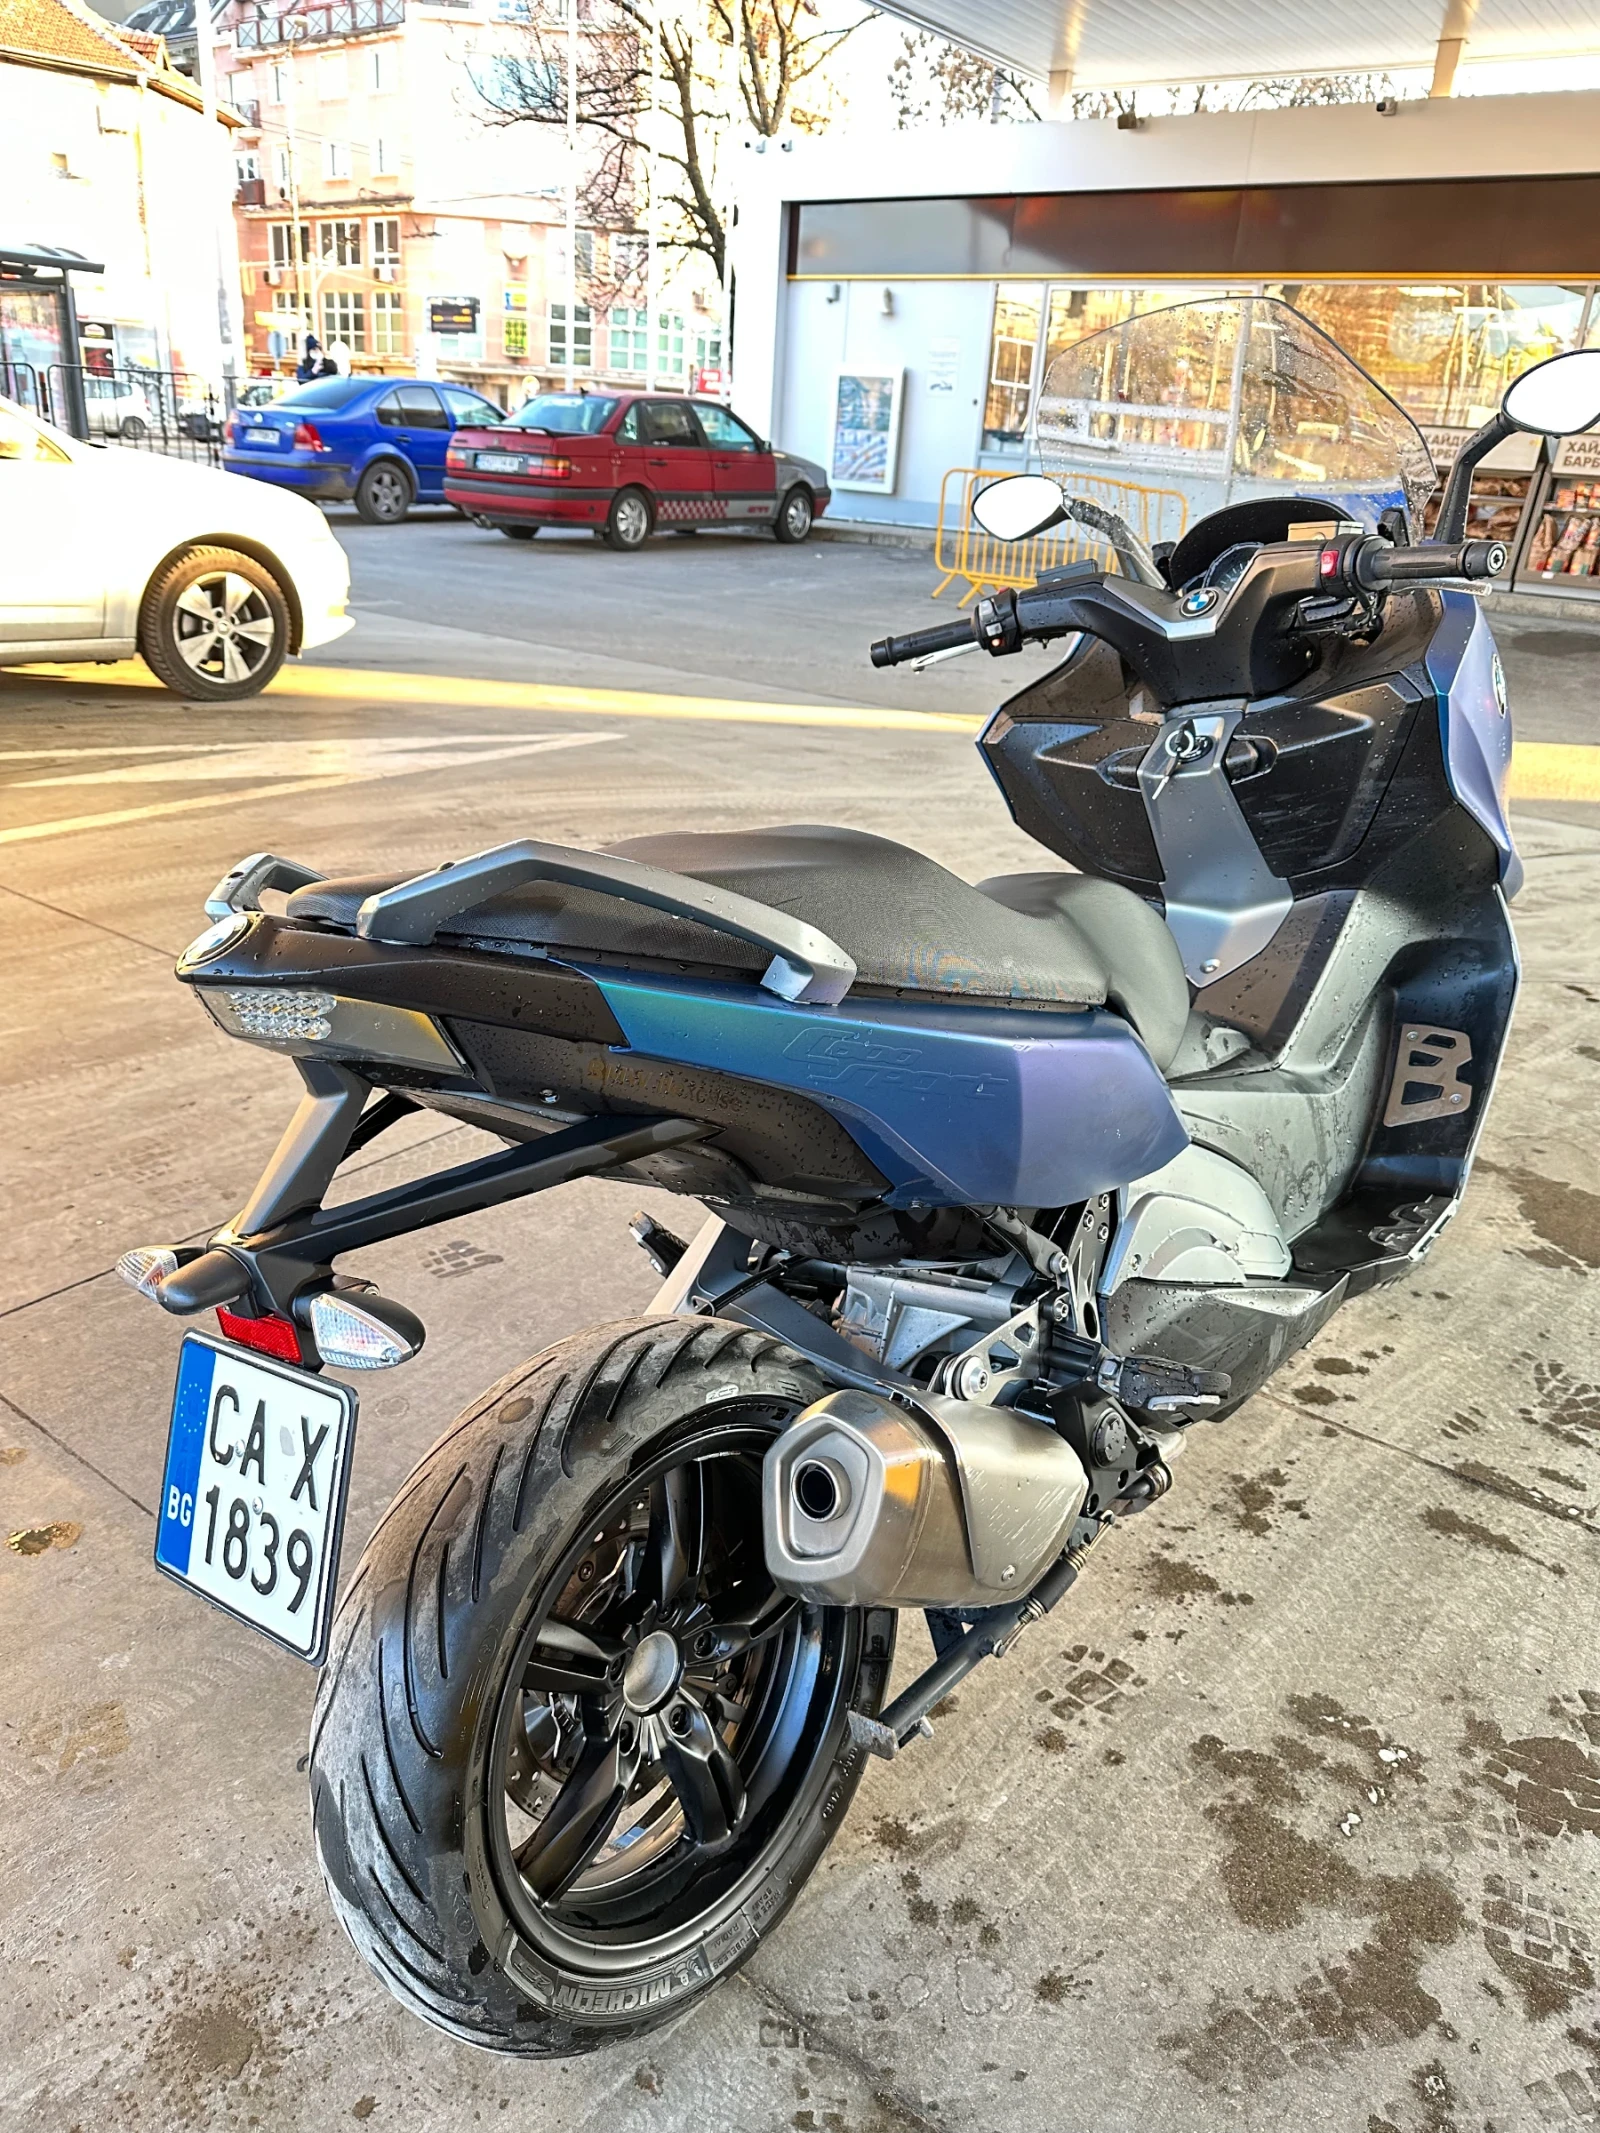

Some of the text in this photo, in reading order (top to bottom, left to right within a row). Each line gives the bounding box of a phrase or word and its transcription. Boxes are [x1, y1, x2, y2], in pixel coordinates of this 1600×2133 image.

[210, 1384, 330, 1512] CA X
[167, 1484, 193, 1527] BG
[205, 1484, 314, 1614] 1839
[712, 1932, 755, 1970] TUBELESS
[713, 1921, 740, 1950] RADIAL
[555, 1975, 672, 2014] MICHELIN
